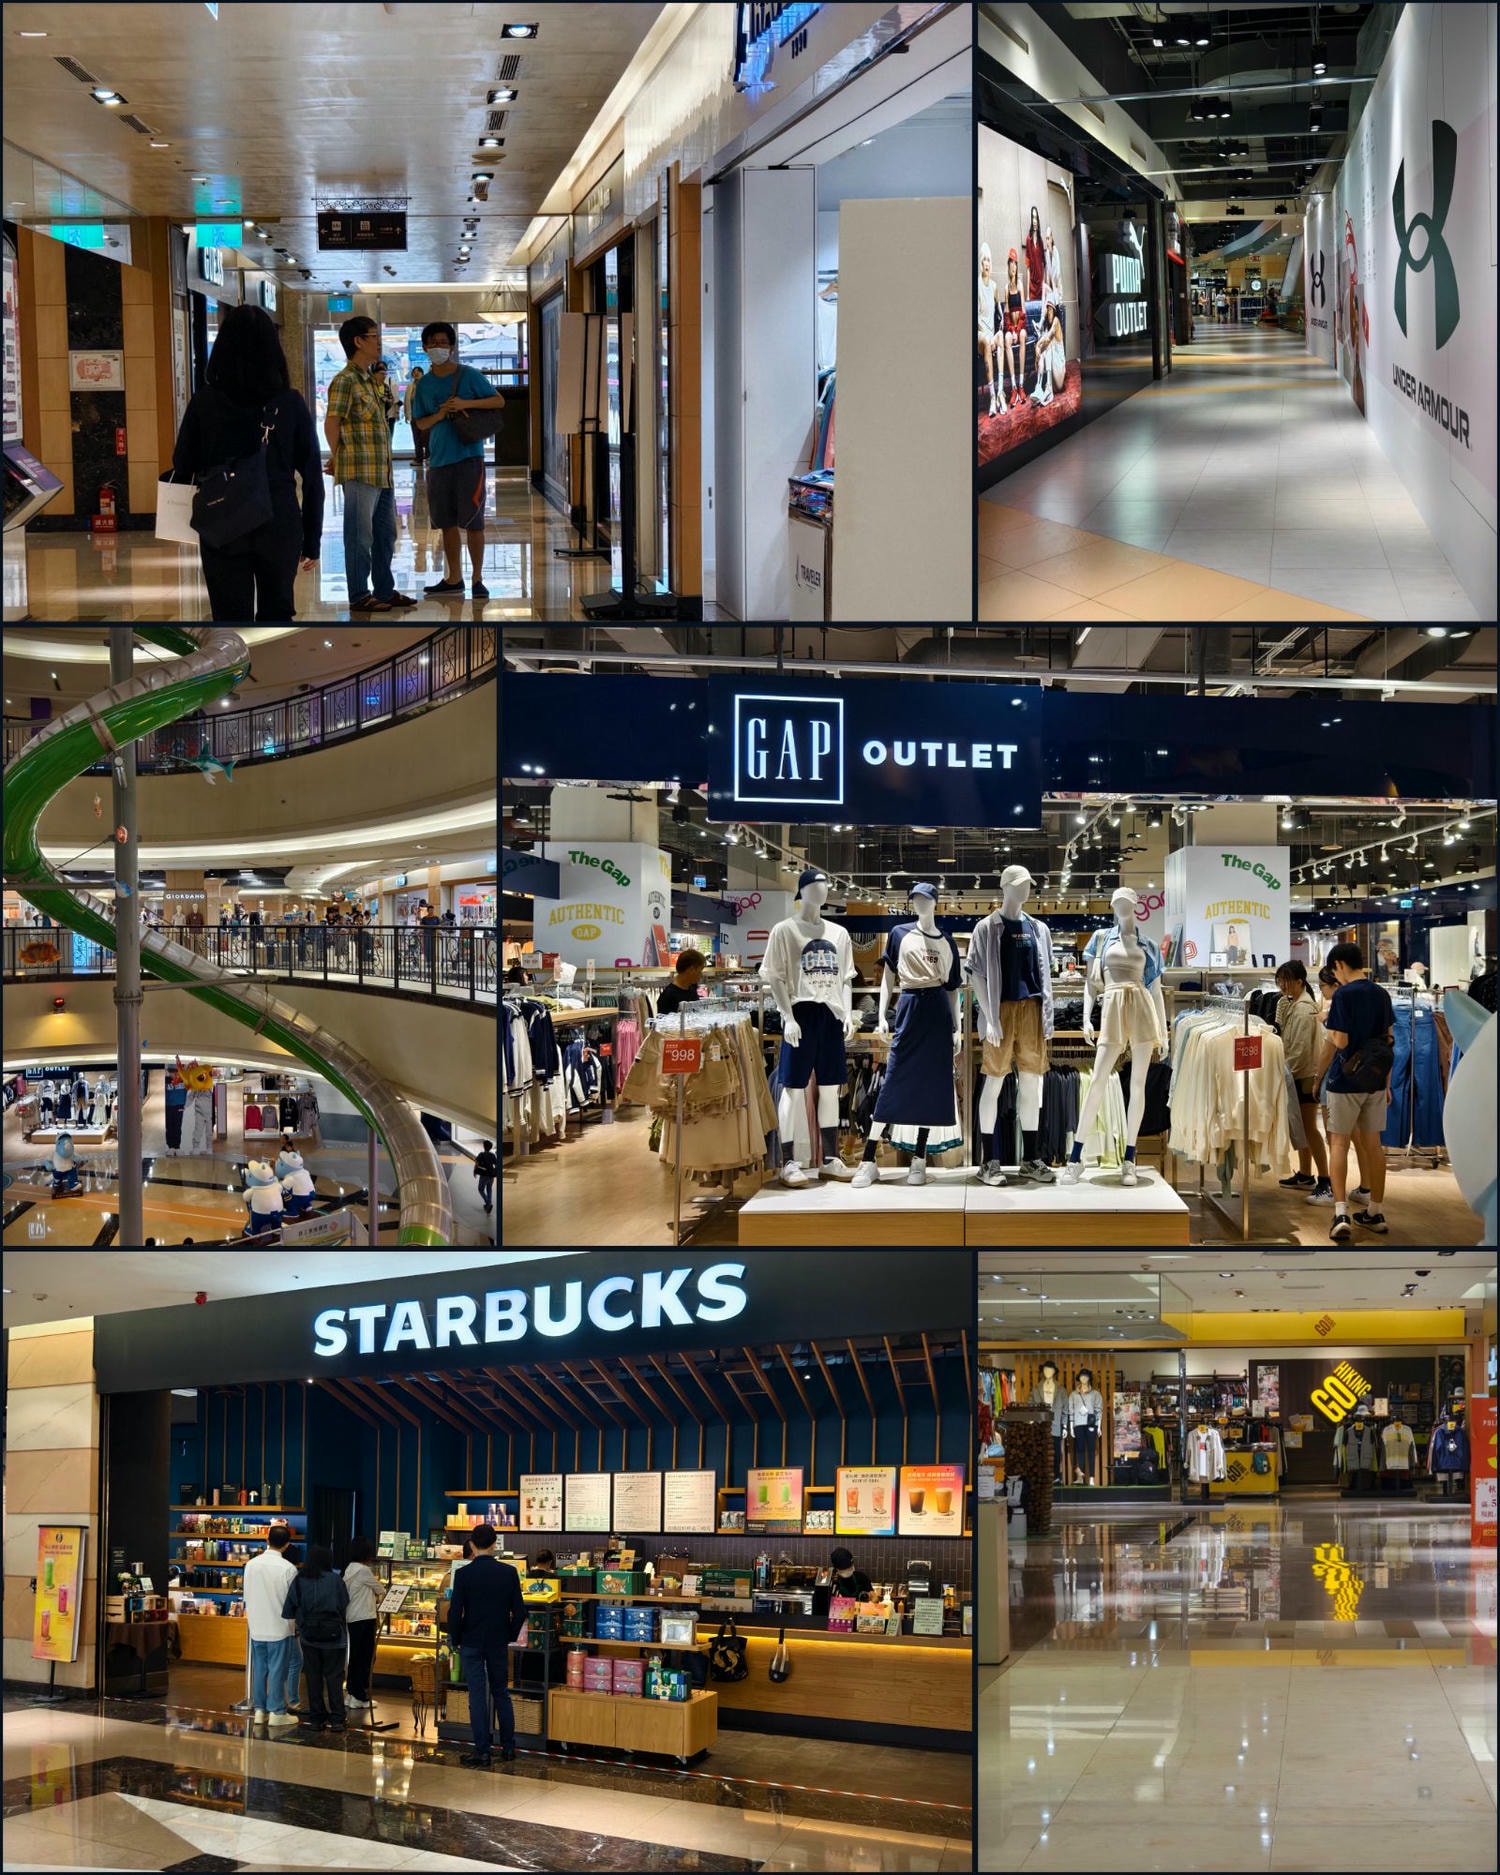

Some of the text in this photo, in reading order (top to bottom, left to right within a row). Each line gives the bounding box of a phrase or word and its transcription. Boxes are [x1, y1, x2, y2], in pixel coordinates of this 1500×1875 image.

[1111, 253, 1142, 294] PUMA
[1115, 301, 1148, 337] OUTLET
[1392, 363, 1470, 449] UNDER ARMOUR
[747, 717, 1018, 781] GAP OUTLET
[568, 850, 631, 887] The Gap
[1221, 853, 1281, 890] The Gap
[548, 903, 625, 926] AUTHENTIC
[1205, 899, 1271, 920] AUTHENTIC
[576, 927, 597, 937] GAP
[672, 1049, 695, 1061] 998
[313, 1263, 748, 1357] STARBUCKS
[1314, 1319, 1331, 1336] GO
[1310, 1360, 1373, 1423] GO HIKING
